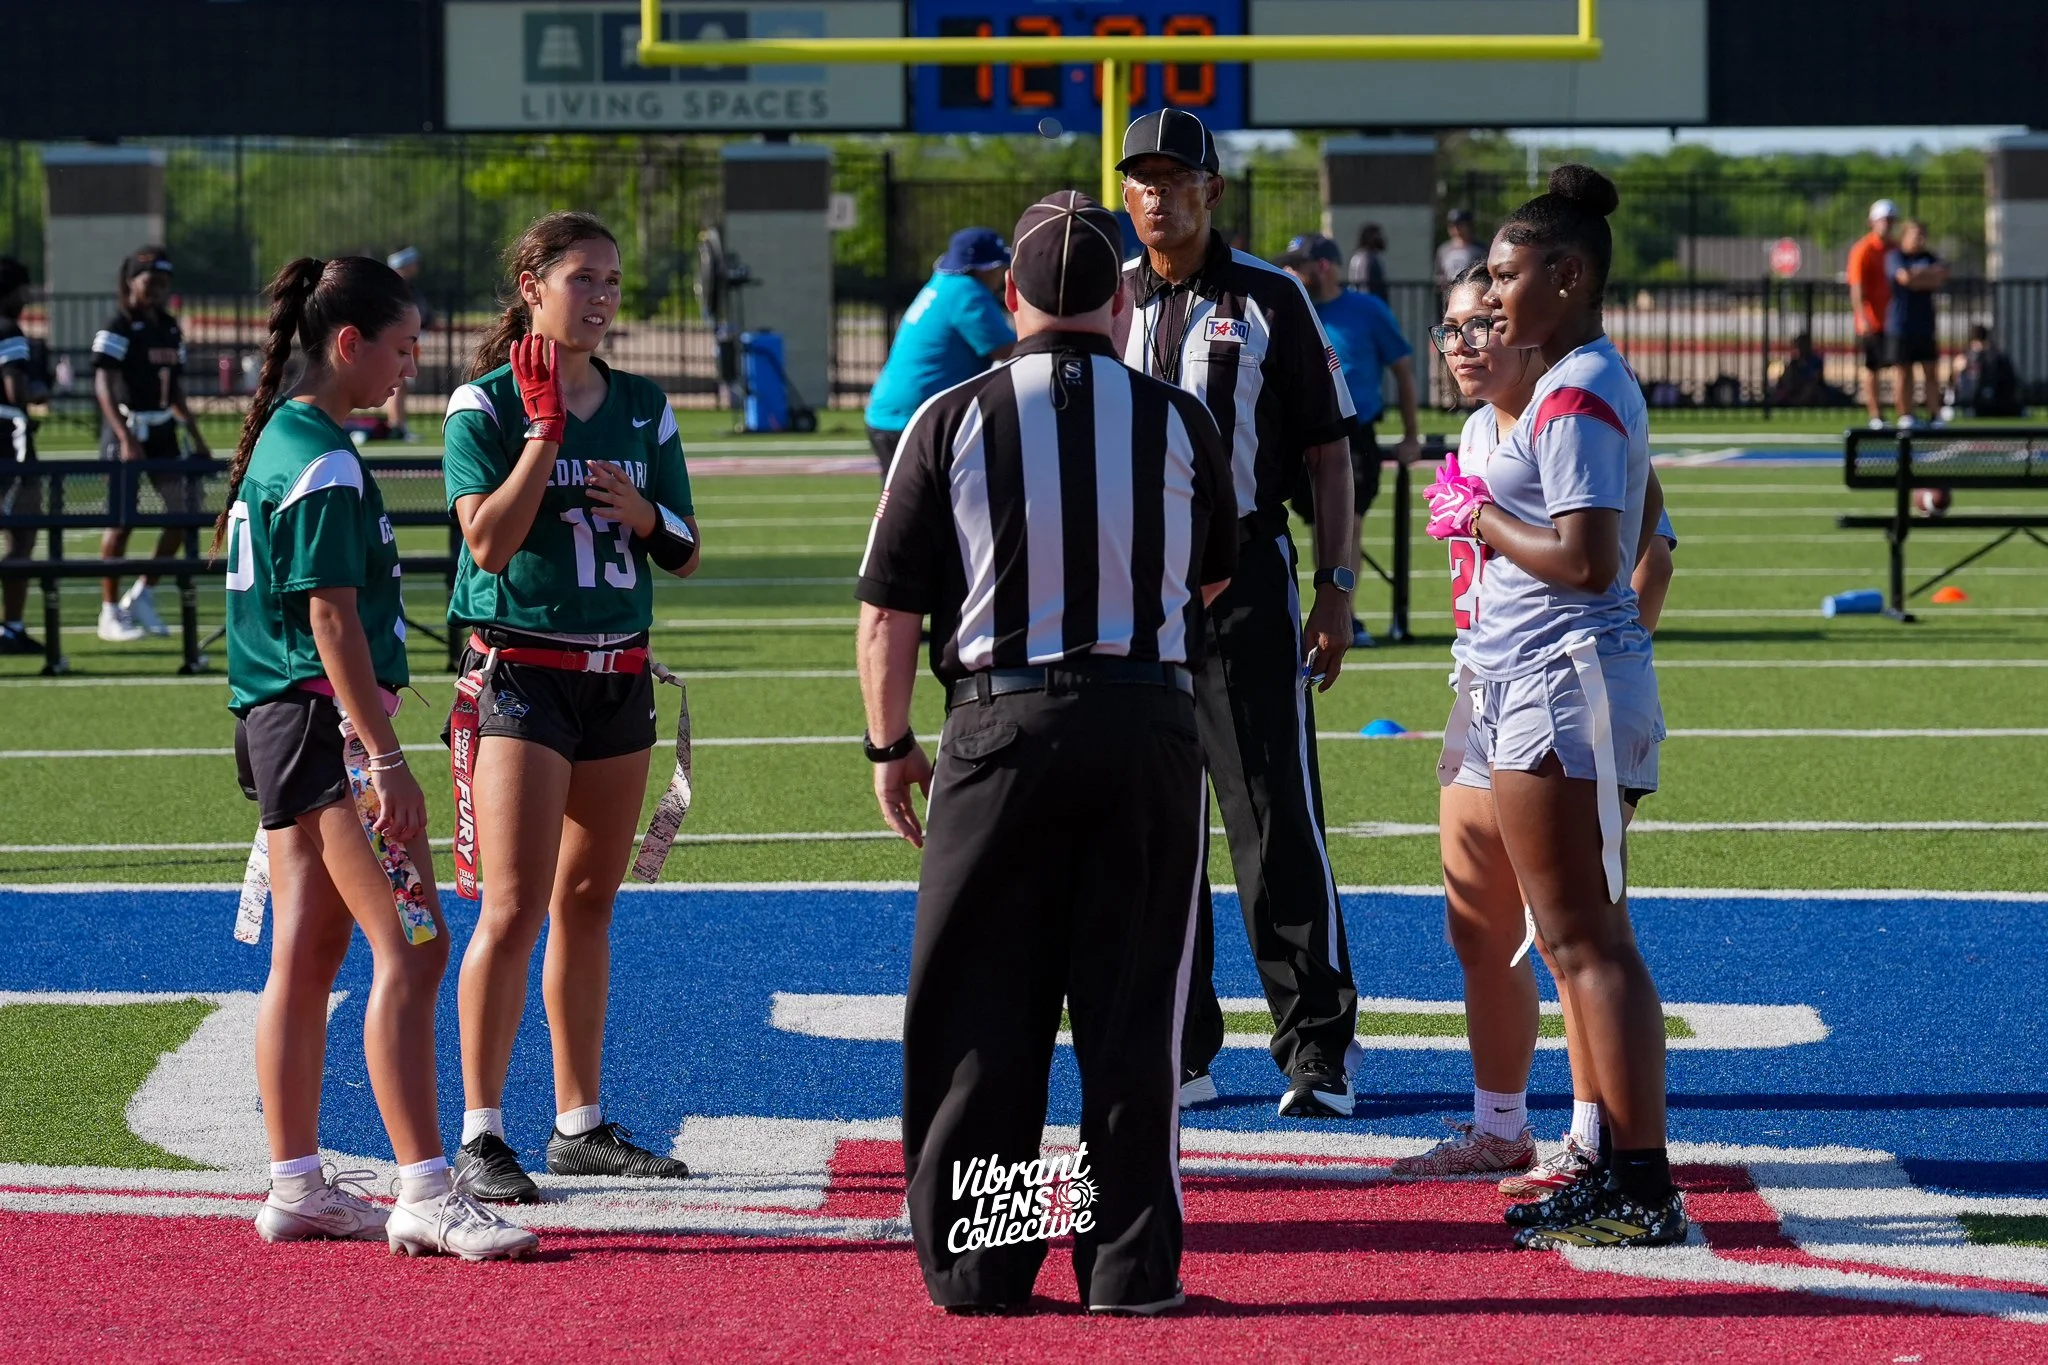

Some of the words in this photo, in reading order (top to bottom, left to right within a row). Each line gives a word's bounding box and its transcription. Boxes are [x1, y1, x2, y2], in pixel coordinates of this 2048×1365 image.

[521, 90, 663, 119] LIVING
[682, 90, 829, 119] SPACES
[560, 507, 637, 590] 13
[454, 729, 463, 769] MESS
[456, 778, 474, 865] FURY
[458, 868, 474, 881] TEXAS
[460, 876, 475, 889] FURY
